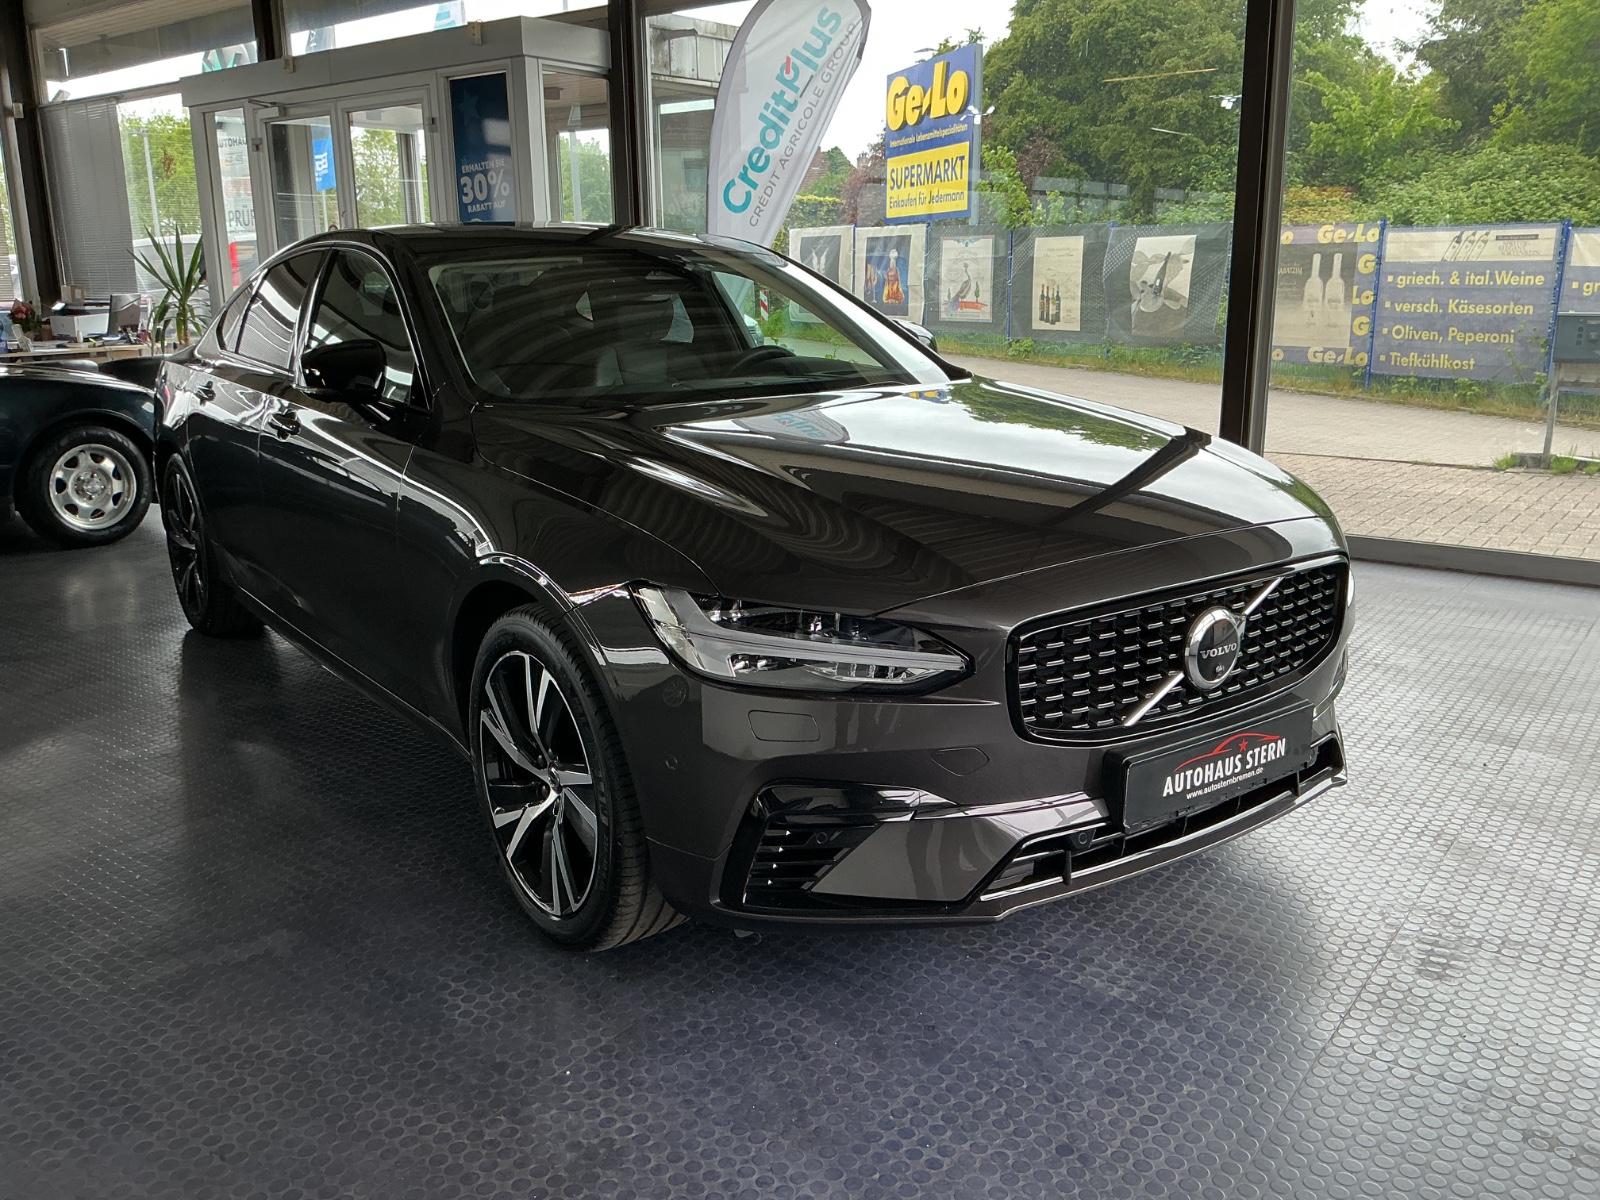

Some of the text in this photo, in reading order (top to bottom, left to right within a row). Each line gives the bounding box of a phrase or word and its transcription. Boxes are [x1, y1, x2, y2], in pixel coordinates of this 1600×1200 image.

[779, 86, 825, 170] AGRICOLE
[462, 160, 495, 174] ERHALTEN
[890, 155, 965, 191] SUPERMARKT
[460, 169, 510, 204] 30%
[467, 202, 492, 214] RABATT
[890, 188, 965, 209] Einkaufen für Jedermann
[1397, 270, 1444, 288] griech.
[1449, 271, 1460, 285] &
[1394, 298, 1534, 315] versch. Käsesorten
[1391, 324, 1515, 345] Oliven, Peperoni
[1389, 351, 1476, 371] Tiefkühlkost
[1200, 643, 1237, 659] VOLVO
[1162, 737, 1286, 797] AUTOHAUS STERN
[1186, 767, 1264, 800] www.autosternbremen.de
